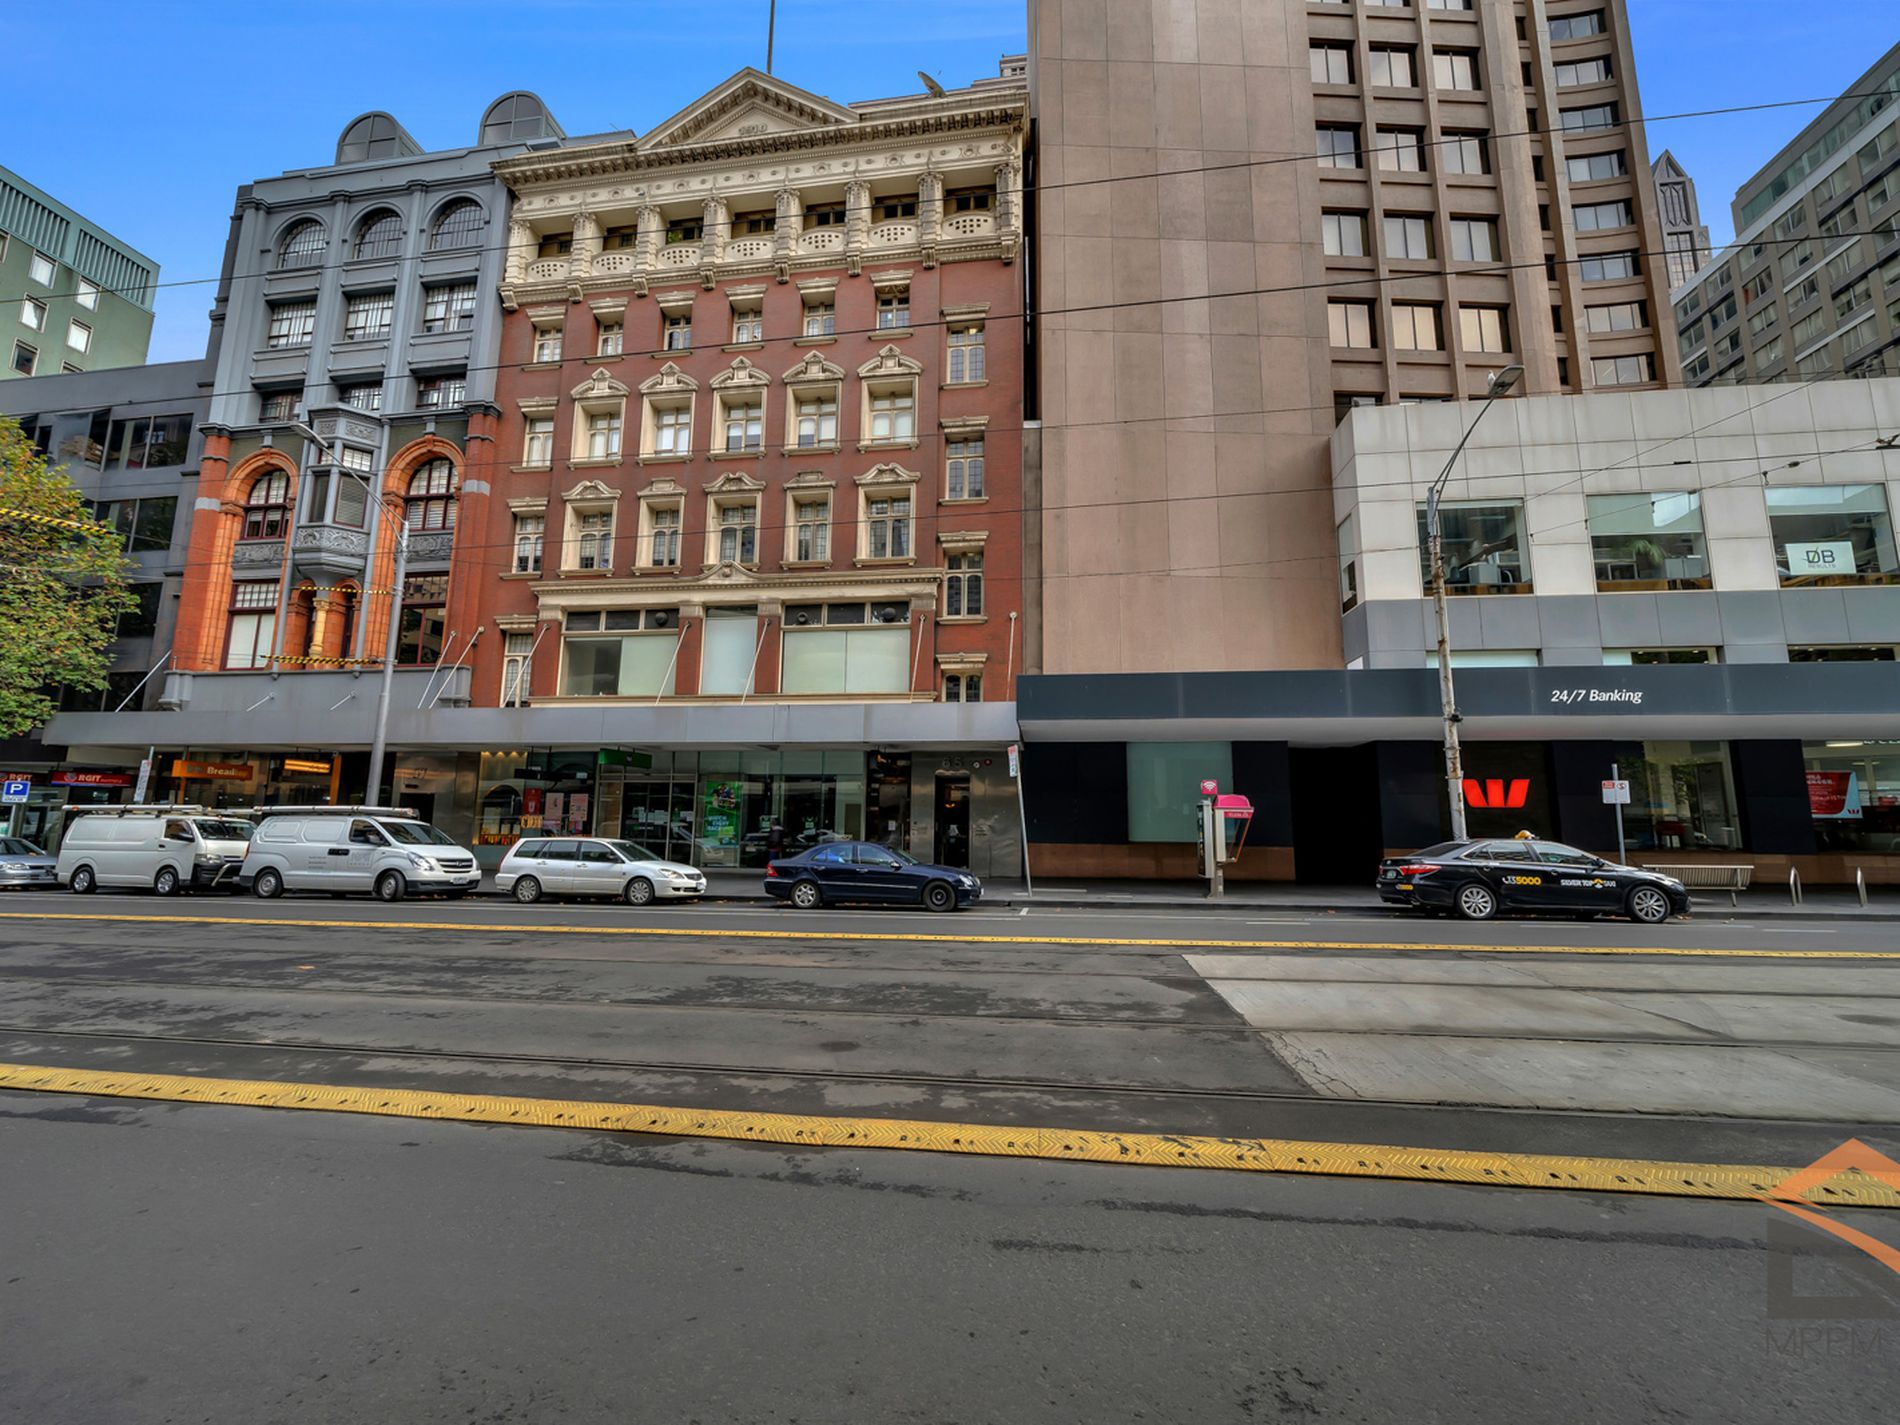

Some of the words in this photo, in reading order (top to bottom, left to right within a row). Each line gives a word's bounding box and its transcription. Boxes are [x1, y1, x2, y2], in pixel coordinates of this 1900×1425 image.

[1551, 689, 1586, 704] 24/7
[1589, 689, 1643, 704] Banking
[78, 774, 101, 782] RGIT
[10, 784, 23, 794] P
